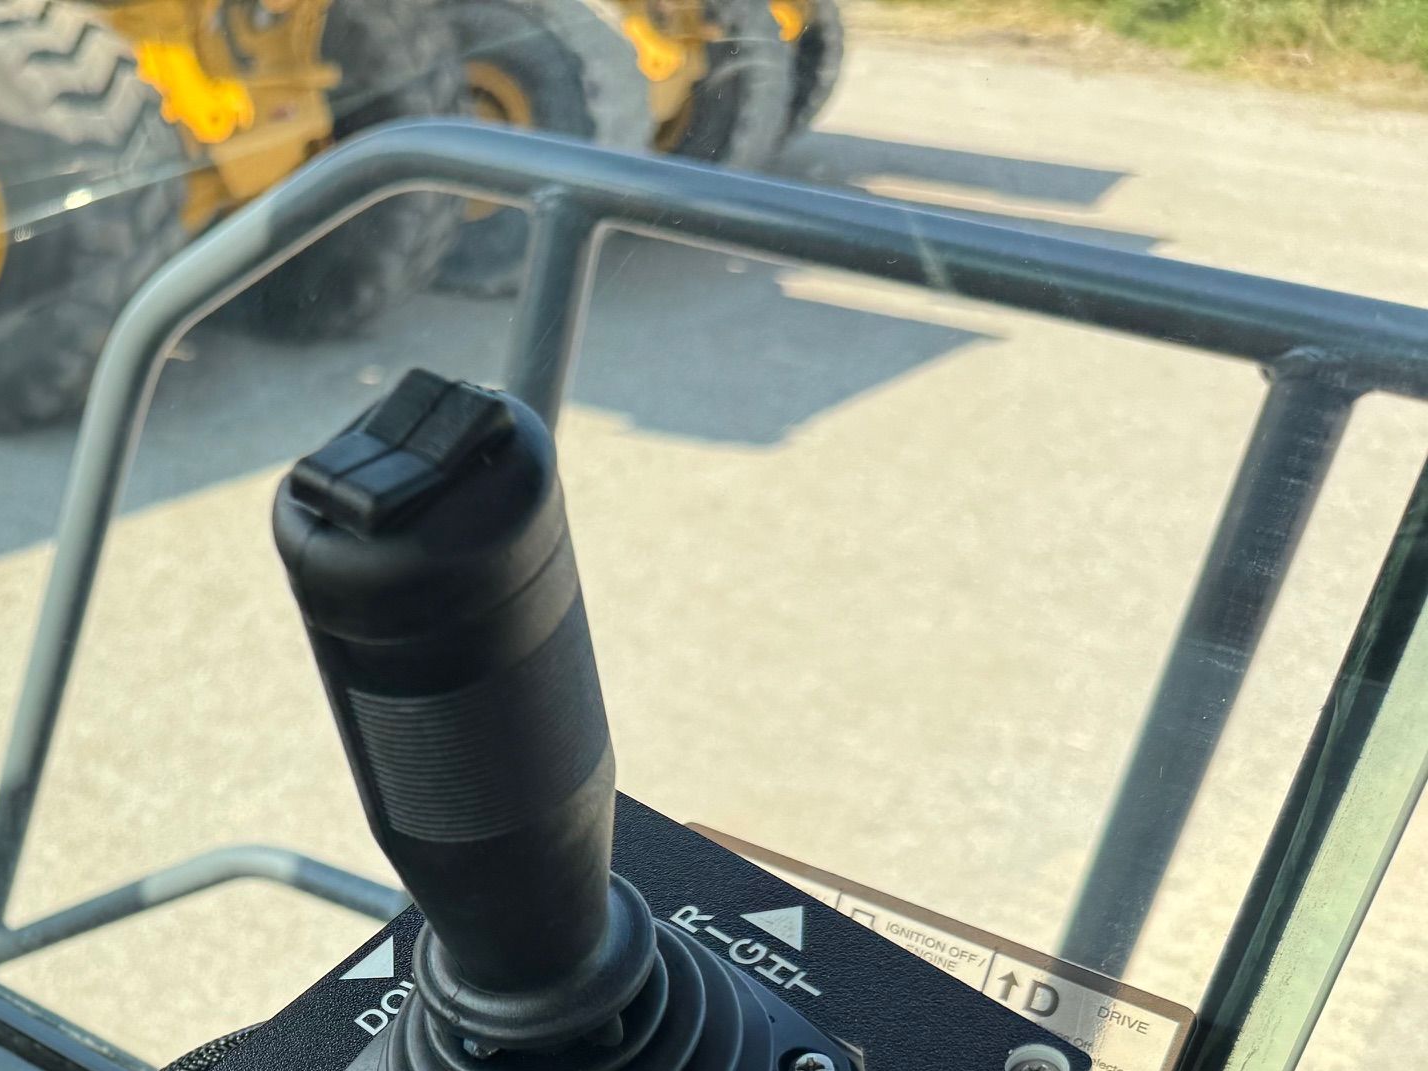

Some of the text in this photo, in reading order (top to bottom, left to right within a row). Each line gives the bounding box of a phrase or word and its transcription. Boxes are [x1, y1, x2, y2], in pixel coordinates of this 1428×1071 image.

[669, 904, 824, 998] RIGHT
[885, 921, 947, 952] IGNITION
[948, 946, 980, 964] OFF
[1023, 979, 1060, 1018] D
[1097, 1006, 1150, 1035] DRIVE
